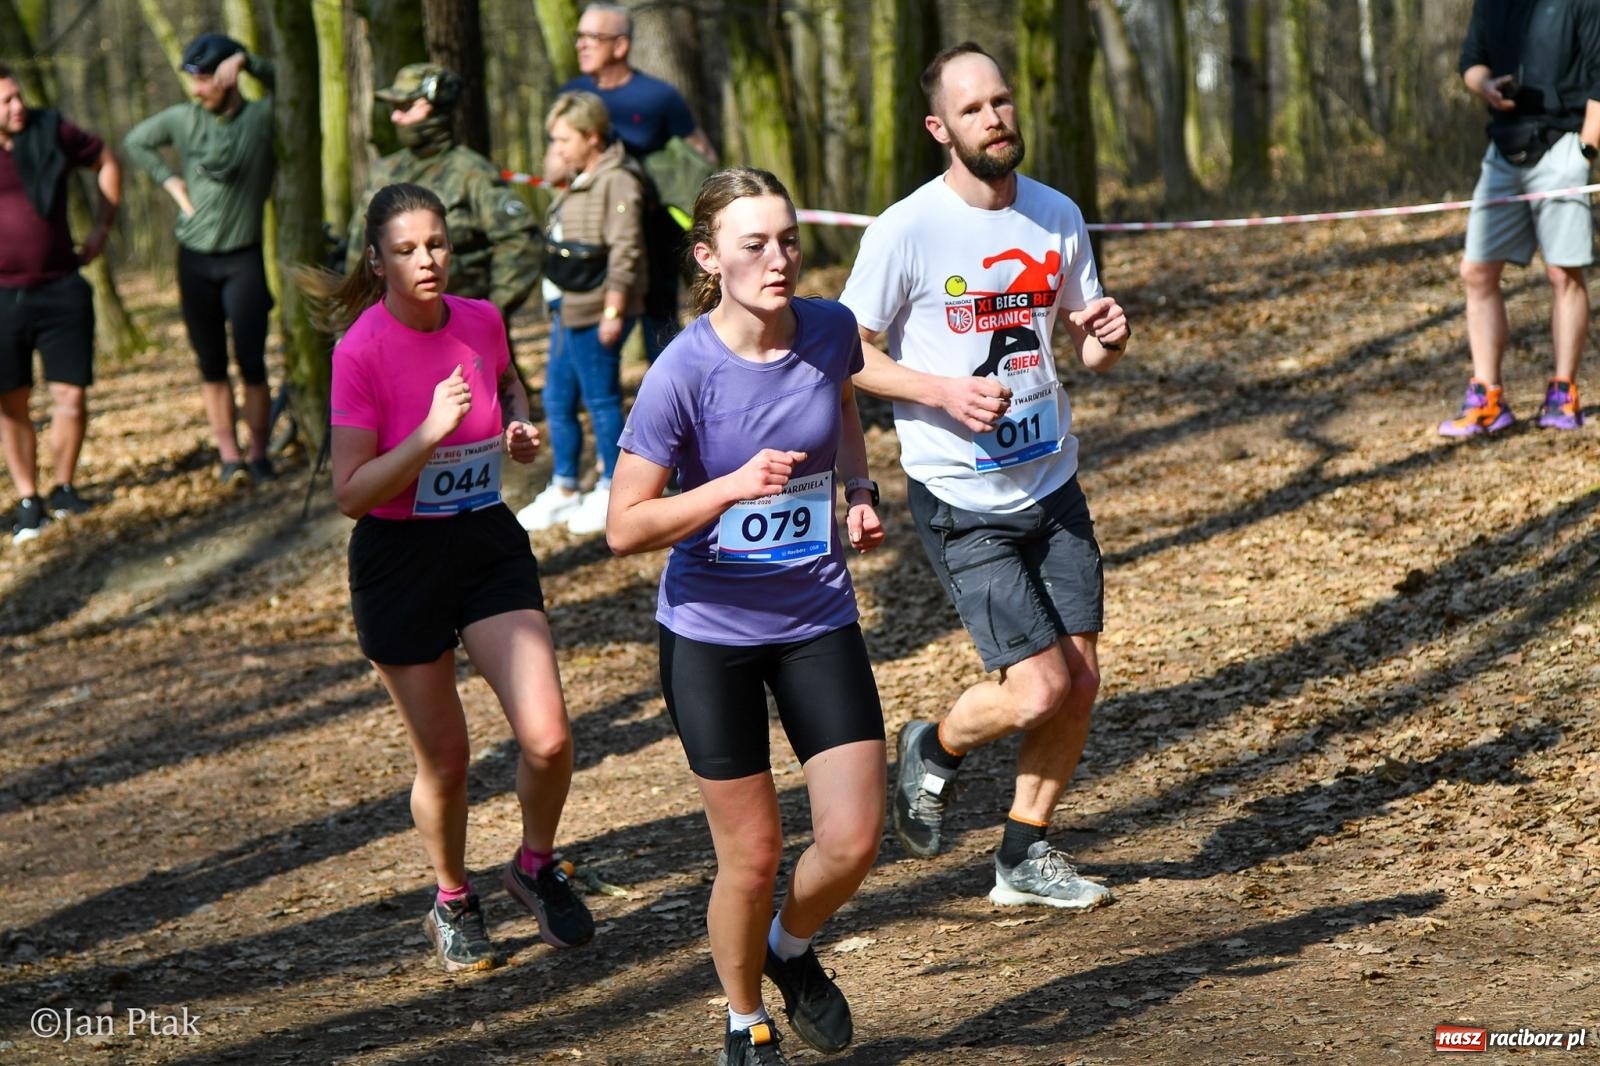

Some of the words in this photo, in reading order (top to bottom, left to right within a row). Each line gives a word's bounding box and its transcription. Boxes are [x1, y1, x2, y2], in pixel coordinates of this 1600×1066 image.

[978, 299, 992, 313] XI
[996, 294, 1028, 310] BIEG
[978, 310, 1030, 329] GRANIC
[1014, 388, 1051, 405] TWARDZIELA
[996, 413, 1040, 448] 011
[433, 463, 491, 496] 044
[741, 506, 811, 542] 079
